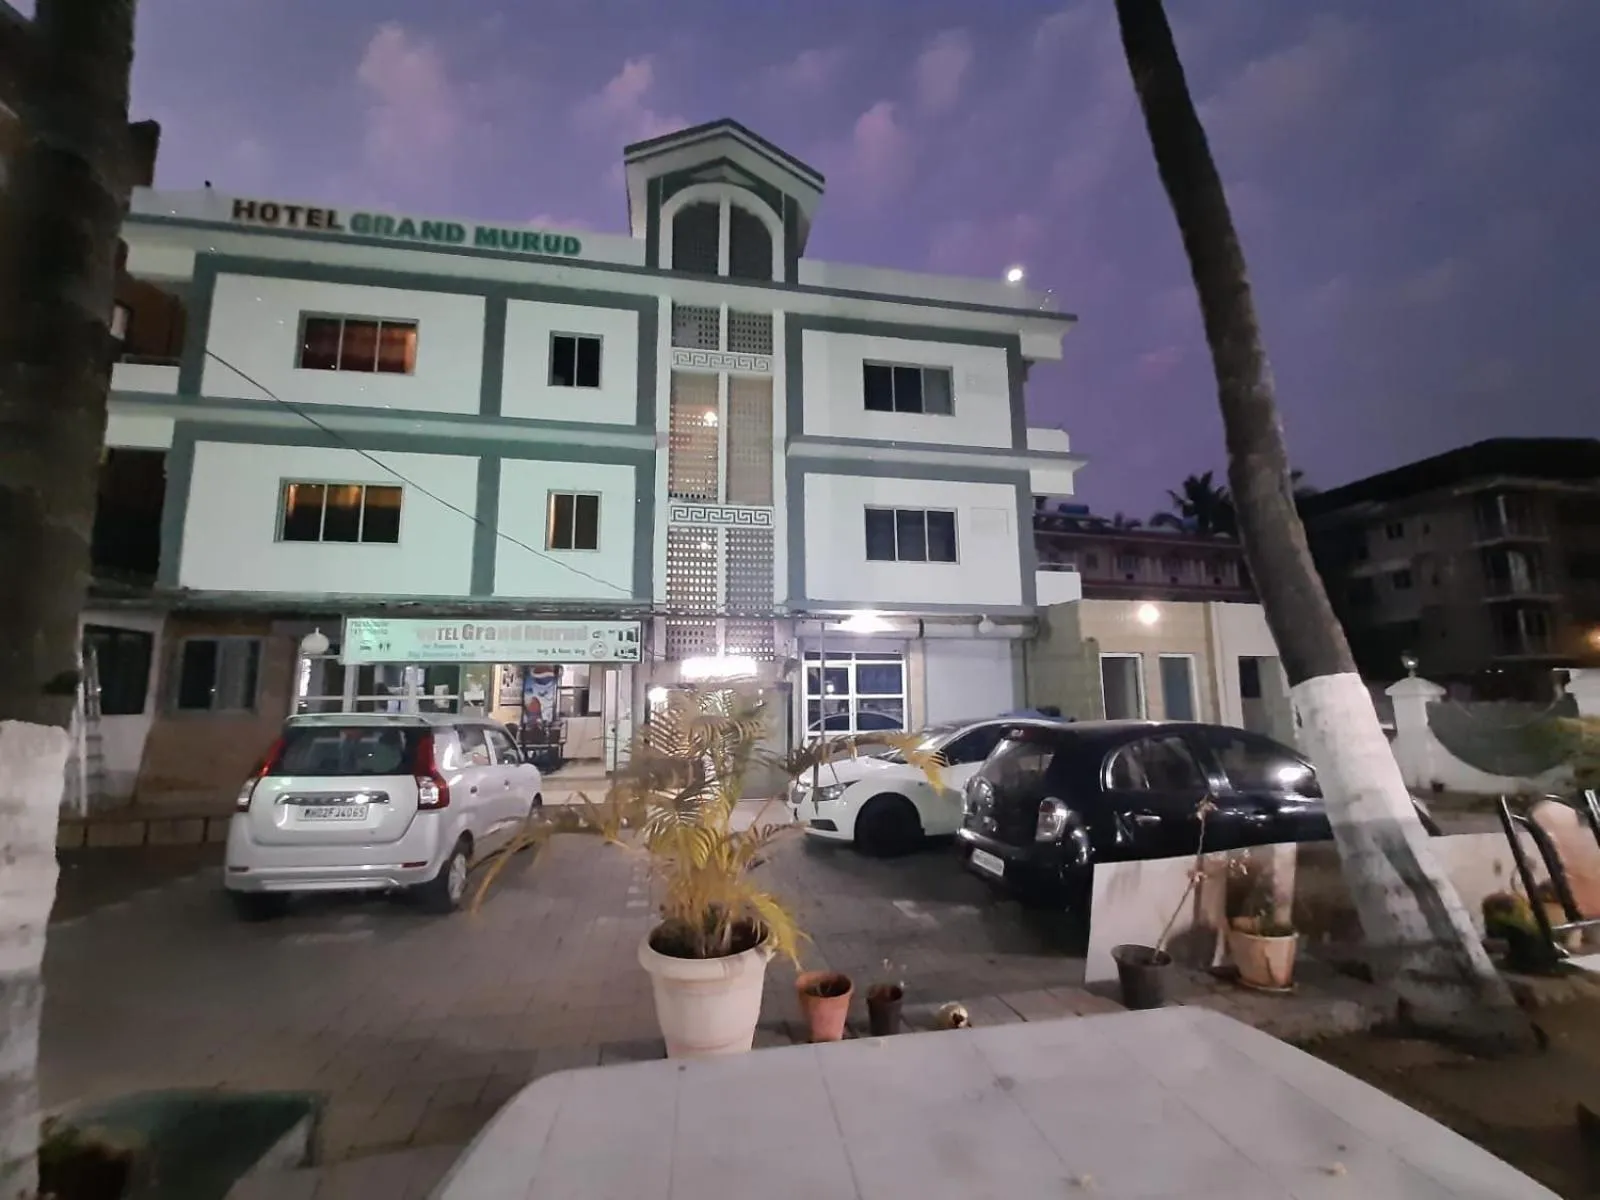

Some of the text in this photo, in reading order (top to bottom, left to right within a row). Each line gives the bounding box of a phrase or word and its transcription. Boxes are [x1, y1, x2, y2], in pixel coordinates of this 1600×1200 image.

[233, 199, 582, 256] HOTEL GRAND MURUD
